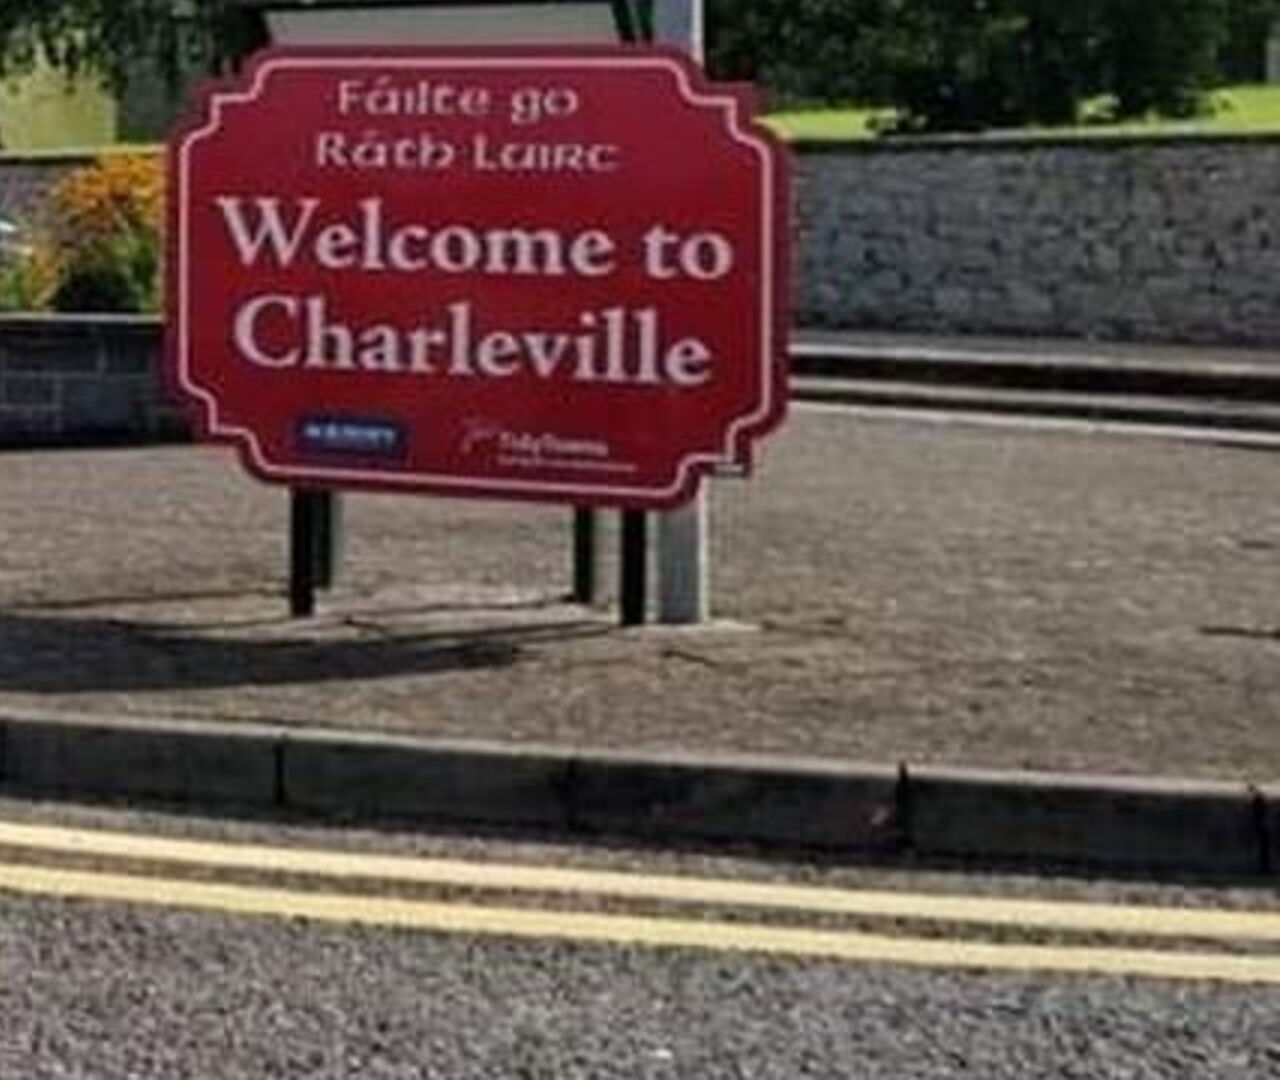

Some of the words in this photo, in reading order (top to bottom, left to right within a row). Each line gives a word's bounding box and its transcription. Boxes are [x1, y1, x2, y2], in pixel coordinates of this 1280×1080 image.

[511, 88, 579, 125] go
[216, 196, 615, 277] Welcome
[644, 223, 734, 280] to
[234, 295, 713, 386] Charleville
